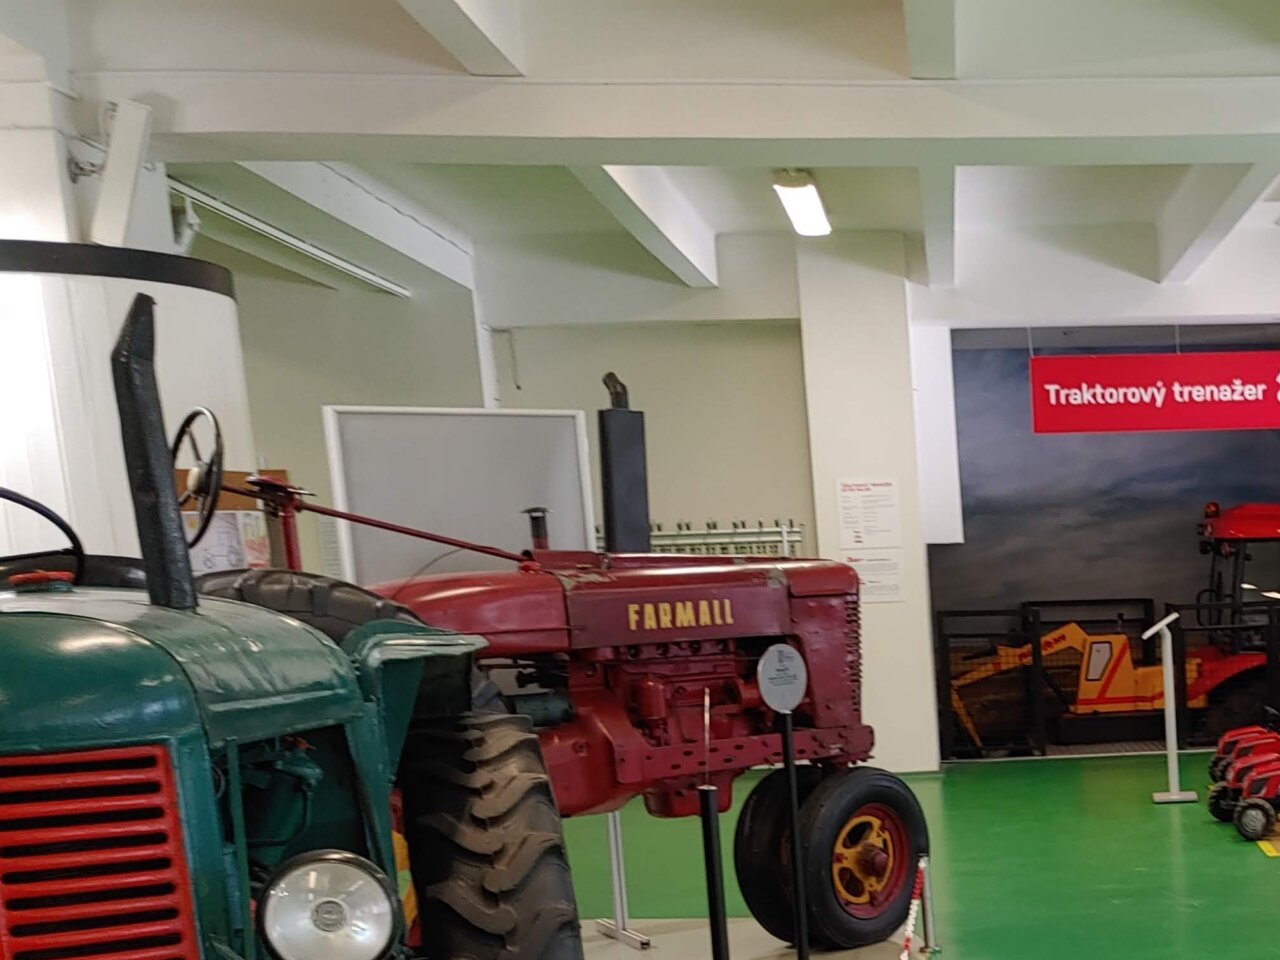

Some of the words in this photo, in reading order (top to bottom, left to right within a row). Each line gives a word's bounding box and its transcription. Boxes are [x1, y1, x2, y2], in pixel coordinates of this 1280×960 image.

[1046, 382, 1166, 408] Traktorový
[1173, 380, 1266, 403] trenažer
[628, 600, 733, 630] FARMALL
